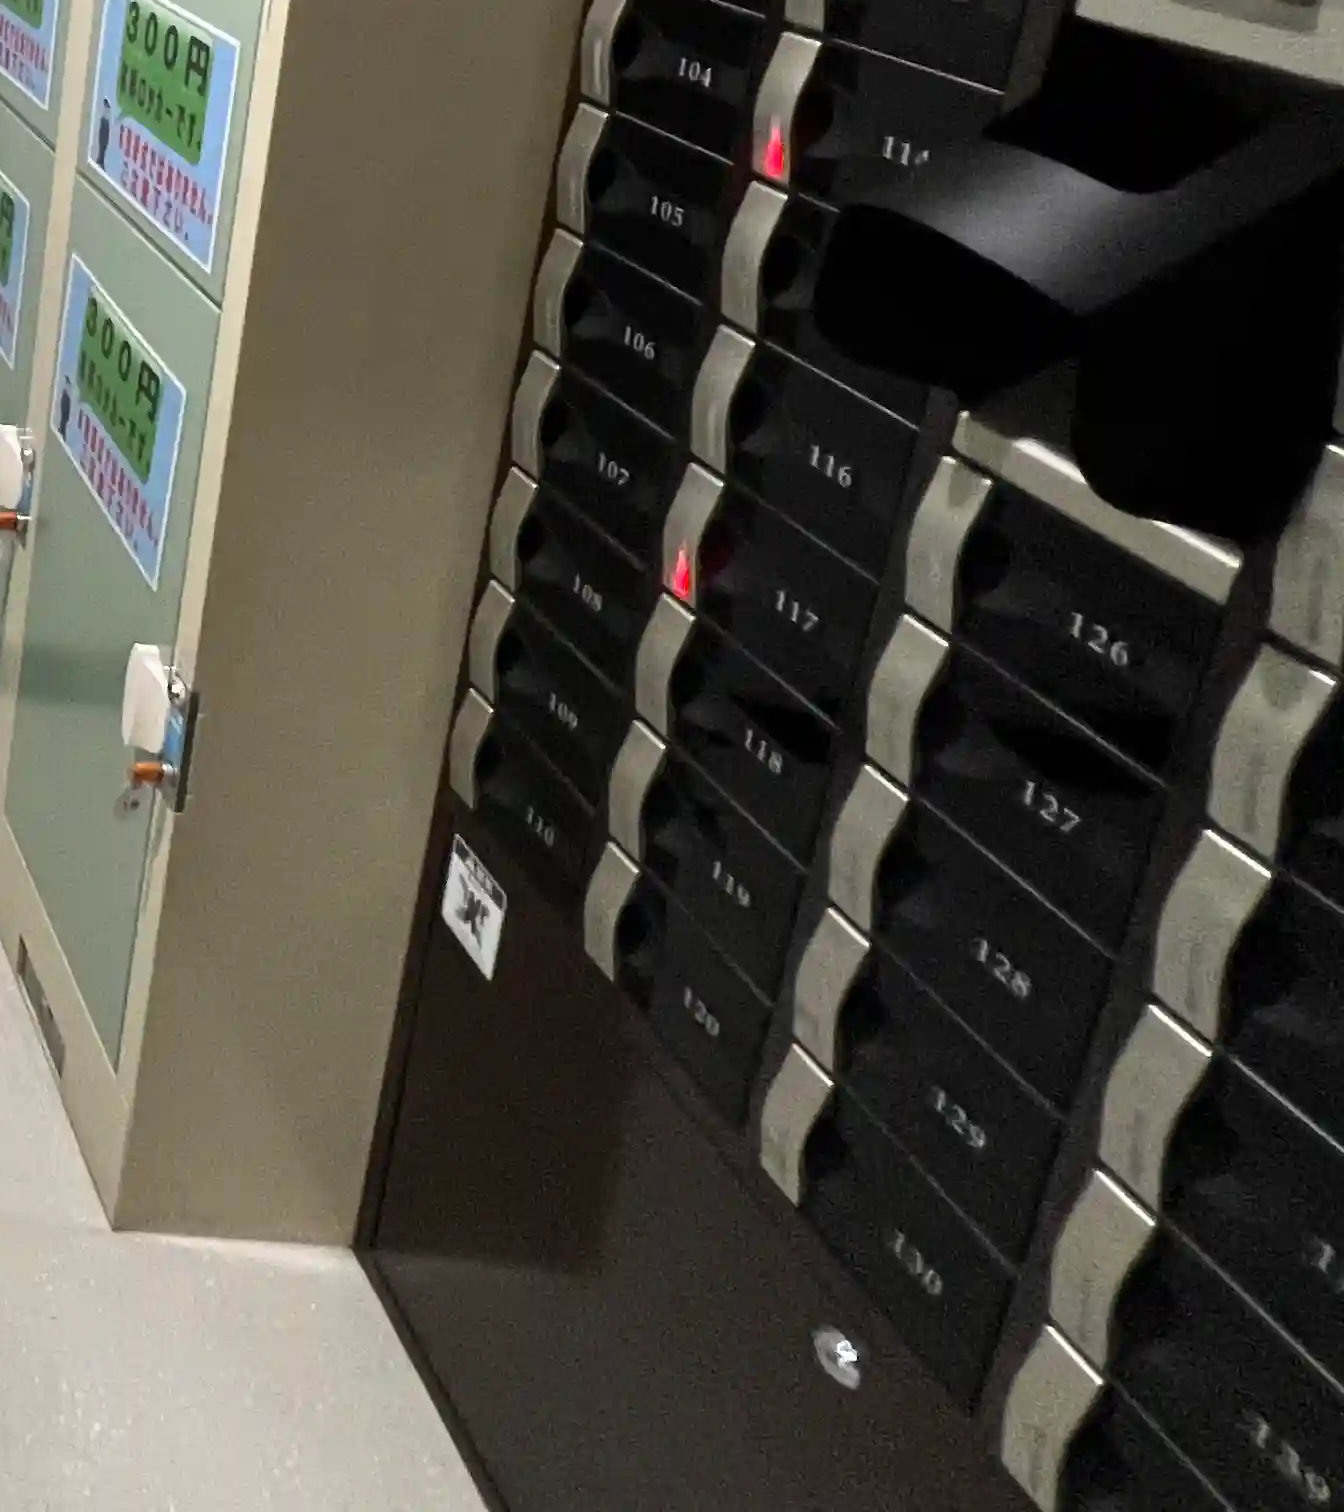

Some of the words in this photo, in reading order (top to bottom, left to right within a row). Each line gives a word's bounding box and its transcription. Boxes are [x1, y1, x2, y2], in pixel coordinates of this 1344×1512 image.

[125, 0, 210, 98] 300円
[677, 56, 713, 88] 104
[648, 195, 685, 229] 105
[622, 324, 657, 362] 106
[596, 452, 630, 487] 107
[808, 444, 854, 490] 116
[773, 588, 821, 634] 117
[1067, 610, 1130, 669] 126
[1021, 779, 1081, 836] 127
